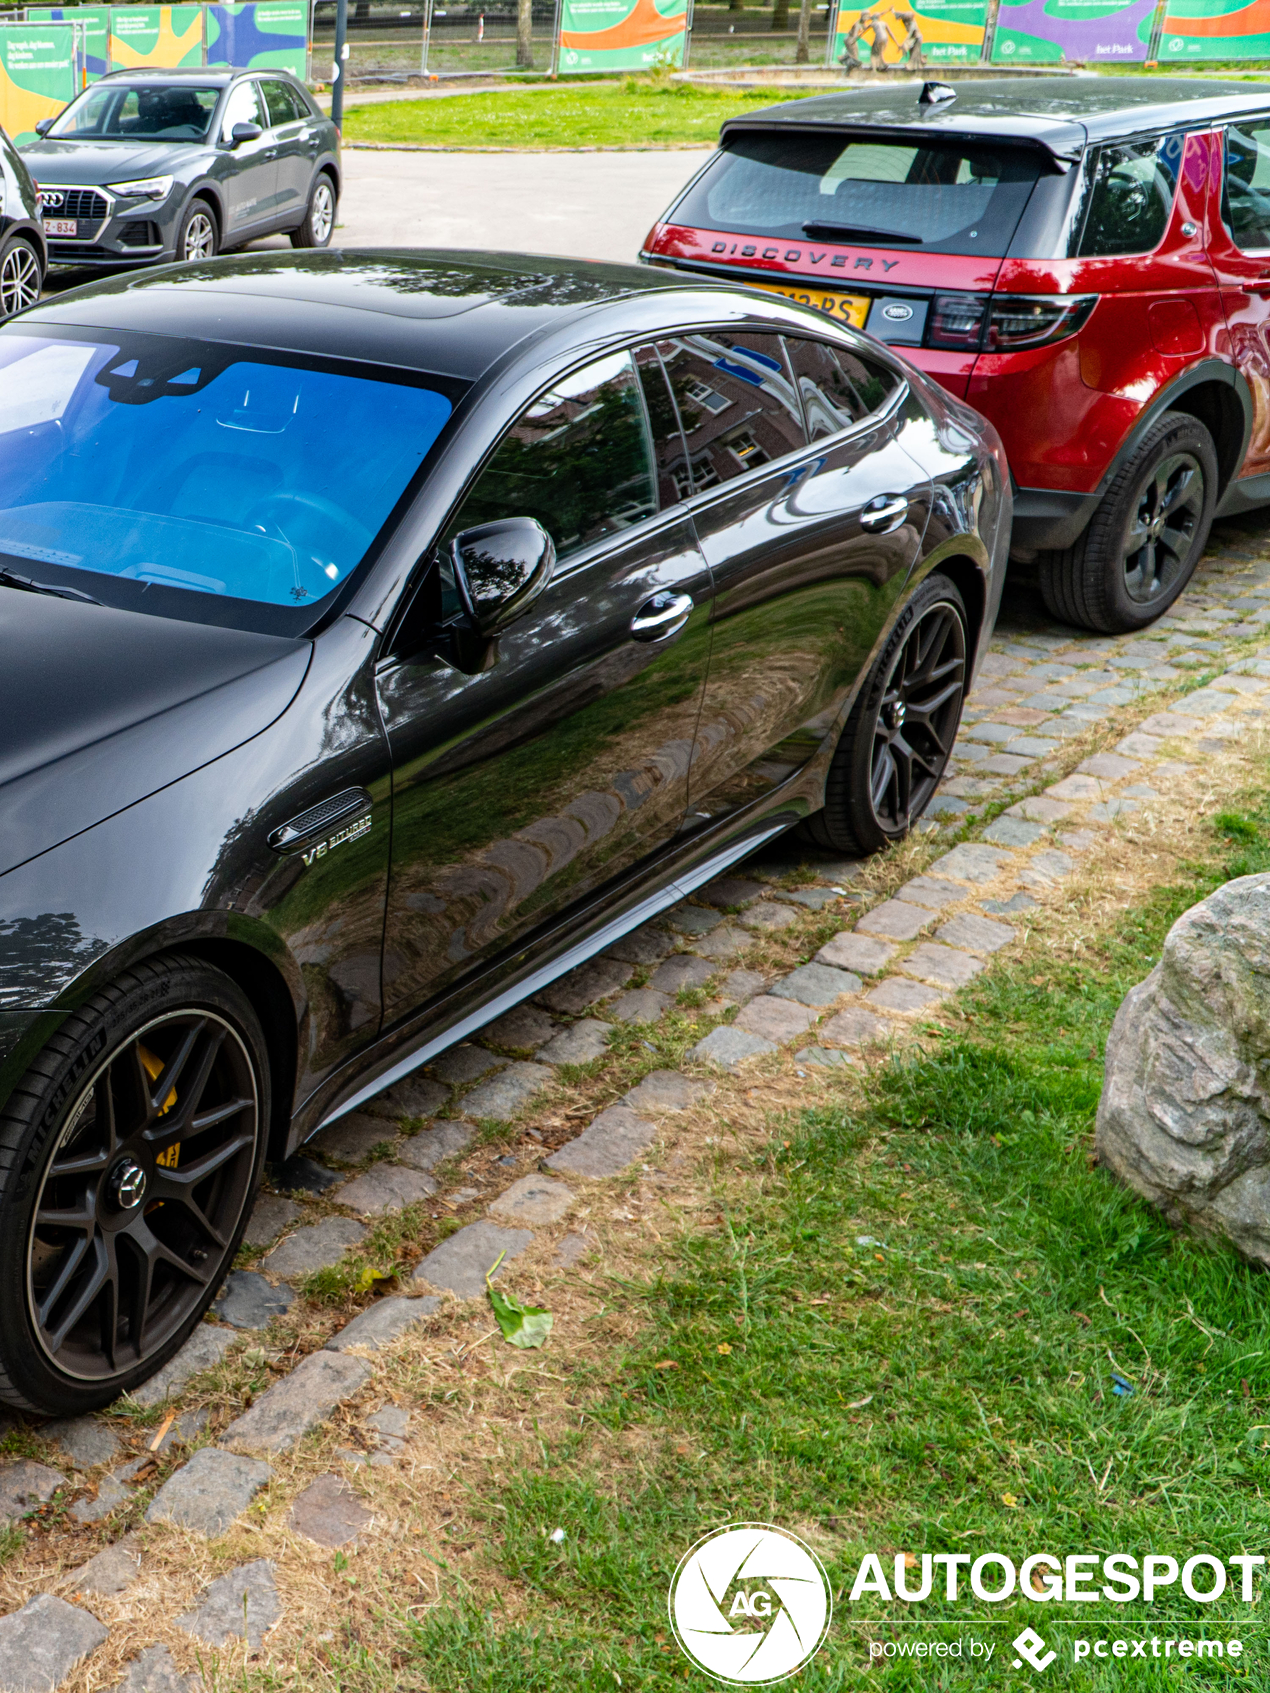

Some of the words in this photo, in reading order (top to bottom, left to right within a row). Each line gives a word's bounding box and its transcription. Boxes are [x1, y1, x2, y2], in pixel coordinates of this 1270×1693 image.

[711, 241, 899, 273] DISCOVERY
[302, 841, 328, 866] V8
[28, 1035, 103, 1164] MICHELIN
